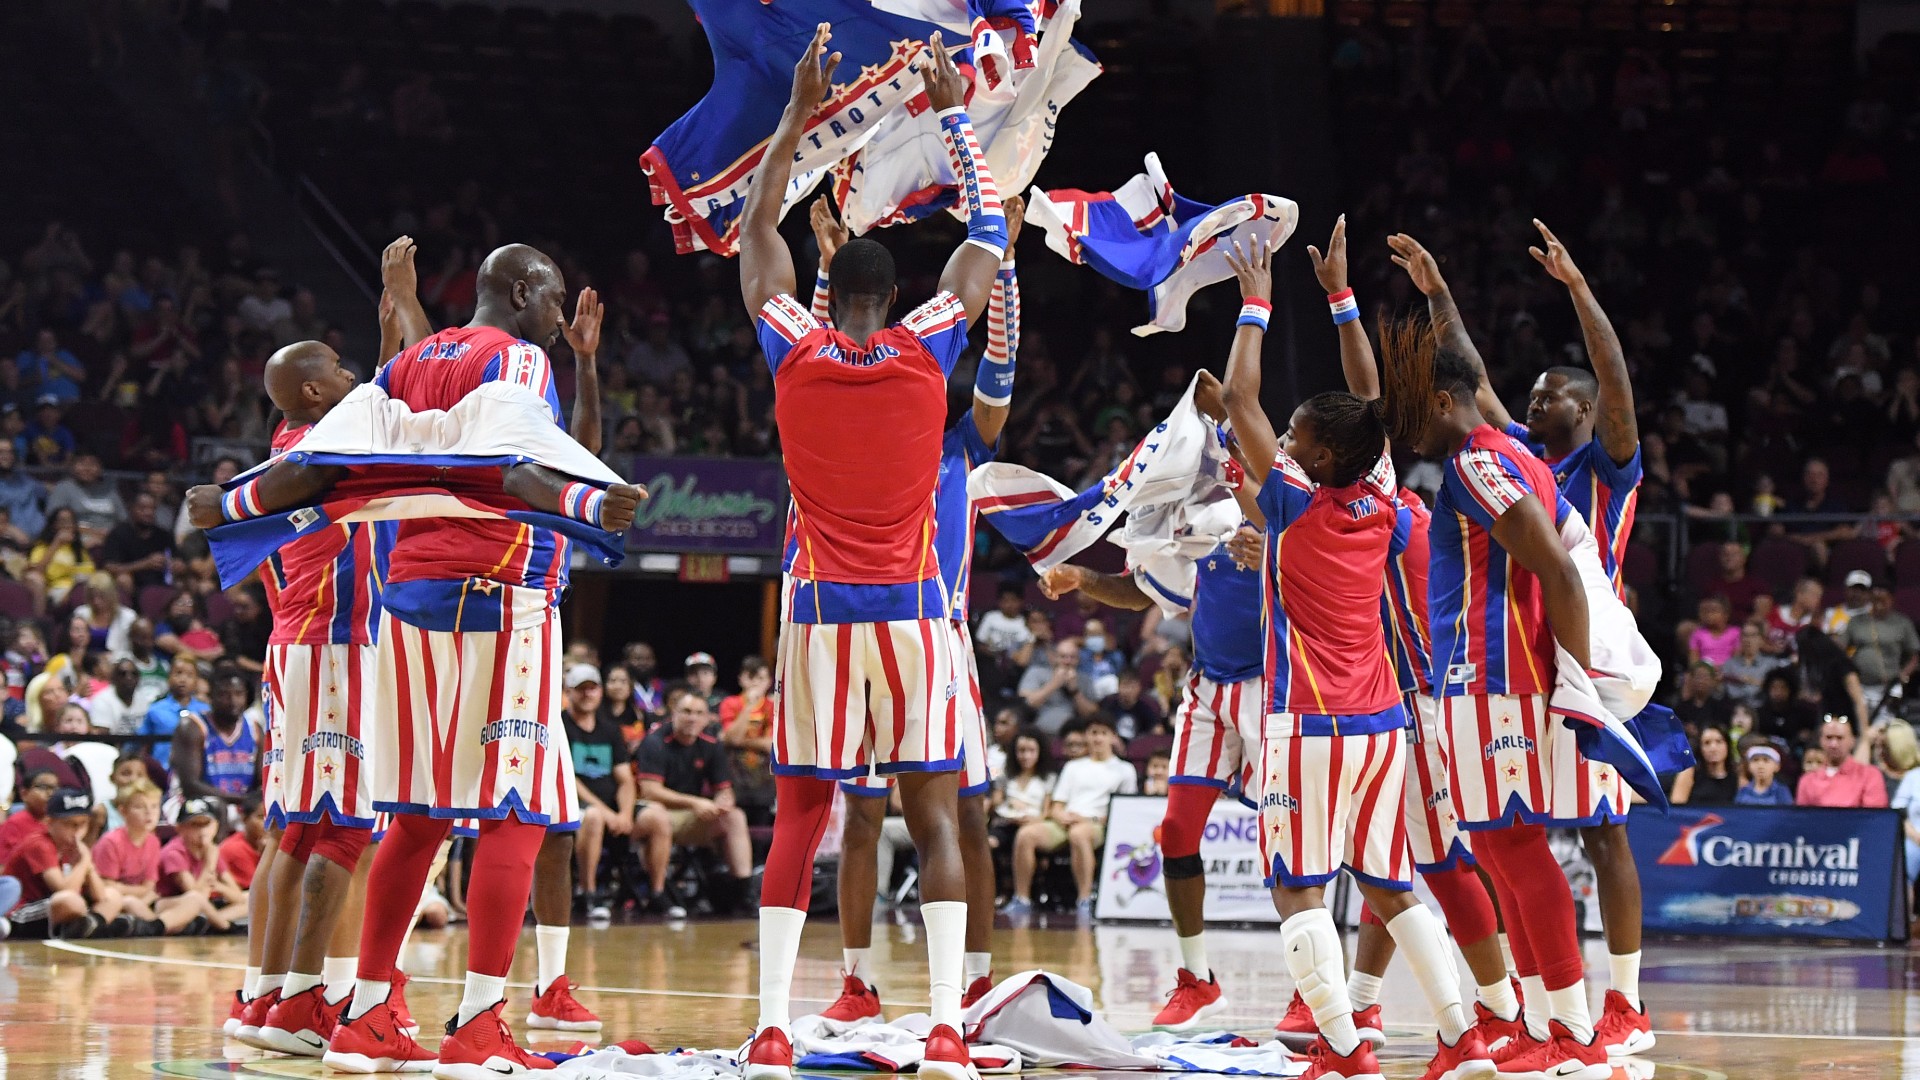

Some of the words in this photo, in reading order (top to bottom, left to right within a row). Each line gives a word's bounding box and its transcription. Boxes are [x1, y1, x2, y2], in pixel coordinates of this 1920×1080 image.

[1346, 494, 1379, 522] TNT
[301, 730, 365, 761] GLOBETROTTERS
[1484, 734, 1535, 761] HARLEM
[1258, 791, 1299, 815] HARLEM
[1702, 835, 1860, 869] Carnival
[1769, 870, 1825, 886] CHOOSE
[1828, 870, 1860, 887] FUN
